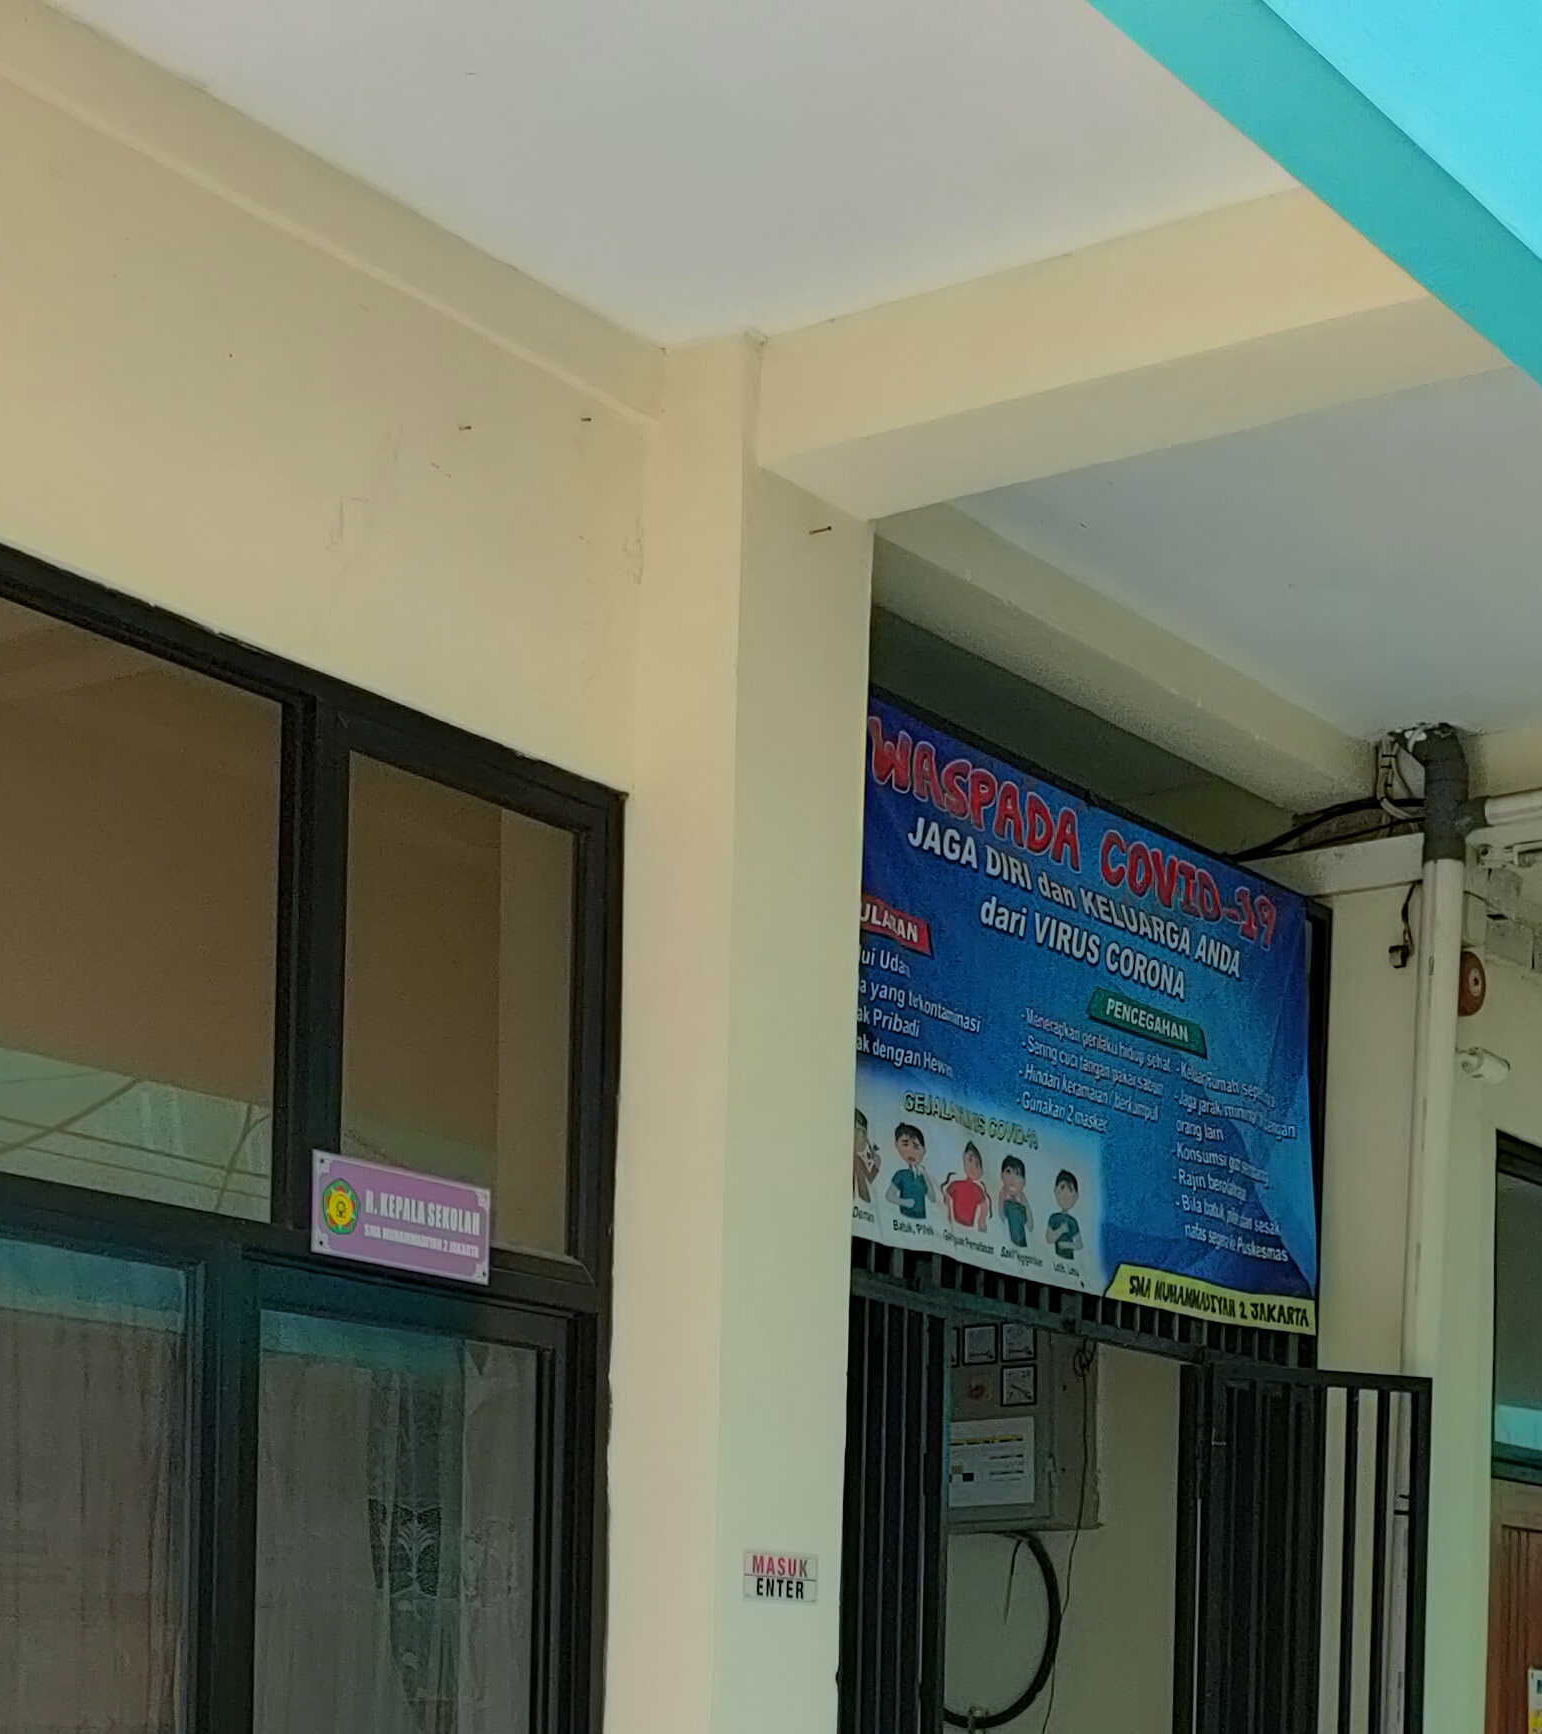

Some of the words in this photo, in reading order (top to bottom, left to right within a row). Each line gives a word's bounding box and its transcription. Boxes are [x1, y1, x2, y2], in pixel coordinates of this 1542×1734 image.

[868, 716, 1082, 874] WASPADA
[1100, 830, 1277, 951] COVID-19
[908, 816, 978, 869] JAGA
[985, 844, 1033, 891] DIRI
[1037, 872, 1077, 909] dan
[1079, 887, 1191, 956] KELUARGA
[1194, 935, 1241, 979] ANDA
[980, 895, 1028, 938] dari
[1035, 911, 1101, 965] VIRUS
[1105, 942, 1185, 1001] CORONA
[870, 981, 906, 1009] yang
[872, 1007, 921, 1038] Pribadi
[1105, 998, 1189, 1042] PENCEGAHAN
[872, 1037, 922, 1067] dengan
[1021, 1091, 1066, 1120] Gunakan
[1066, 1104, 1074, 1124] 2
[1074, 1110, 1108, 1133] masker
[1176, 1119, 1203, 1141] orang
[1203, 1121, 1225, 1140] lain
[1176, 1142, 1228, 1166] Konsumsi
[1178, 1168, 1207, 1191] Rajin
[365, 1189, 378, 1215] R.
[380, 1192, 426, 1225] KEPALA
[427, 1202, 481, 1236] SEKOLAH
[1181, 1193, 1203, 1214] Bila
[1253, 1220, 1282, 1236] sesak
[363, 1223, 382, 1239] SMA
[442, 1239, 449, 1253] 2
[448, 1240, 480, 1259] JAKARTA
[1237, 1236, 1289, 1262] Puskesmas
[1128, 1274, 1152, 1300] SMA
[1239, 1303, 1249, 1320] 2
[1250, 1302, 1310, 1328] JAKARTA
[752, 1554, 808, 1578] MASUK
[756, 1577, 804, 1600] ENTER
